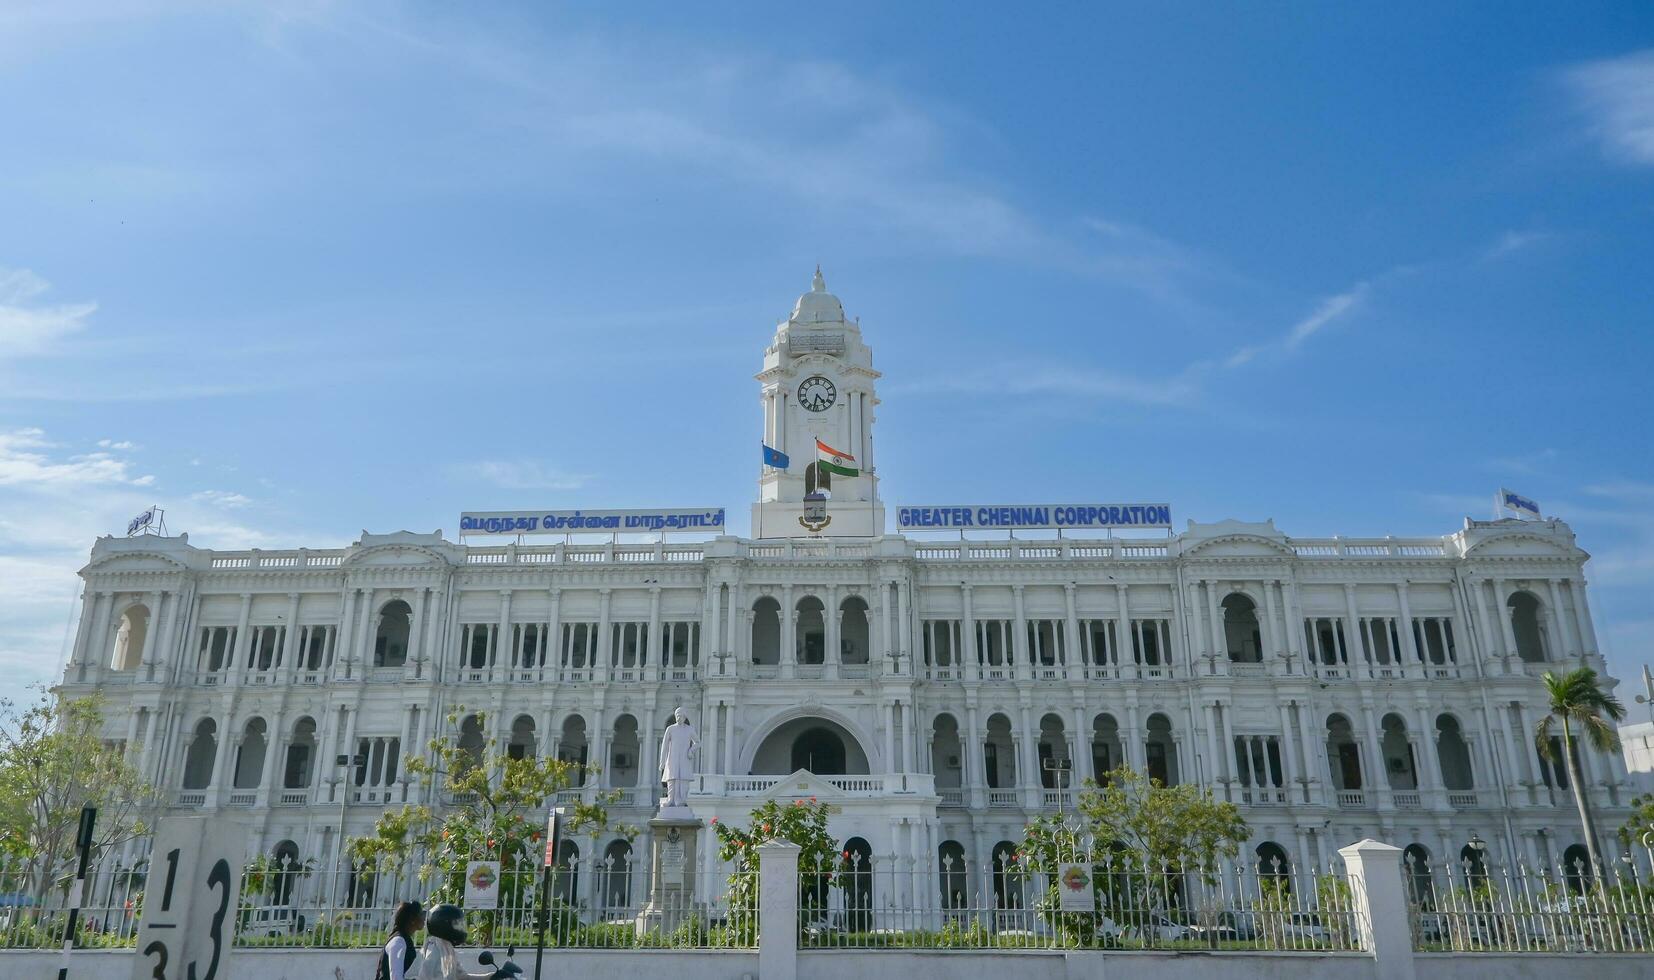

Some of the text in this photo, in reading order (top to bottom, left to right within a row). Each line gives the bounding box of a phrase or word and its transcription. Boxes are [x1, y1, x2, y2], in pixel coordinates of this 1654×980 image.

[460, 509, 725, 533] பெருநகர சென்னை மாநகராட்சி
[900, 506, 1170, 526] GREATER CHENNAI CORPORATION
